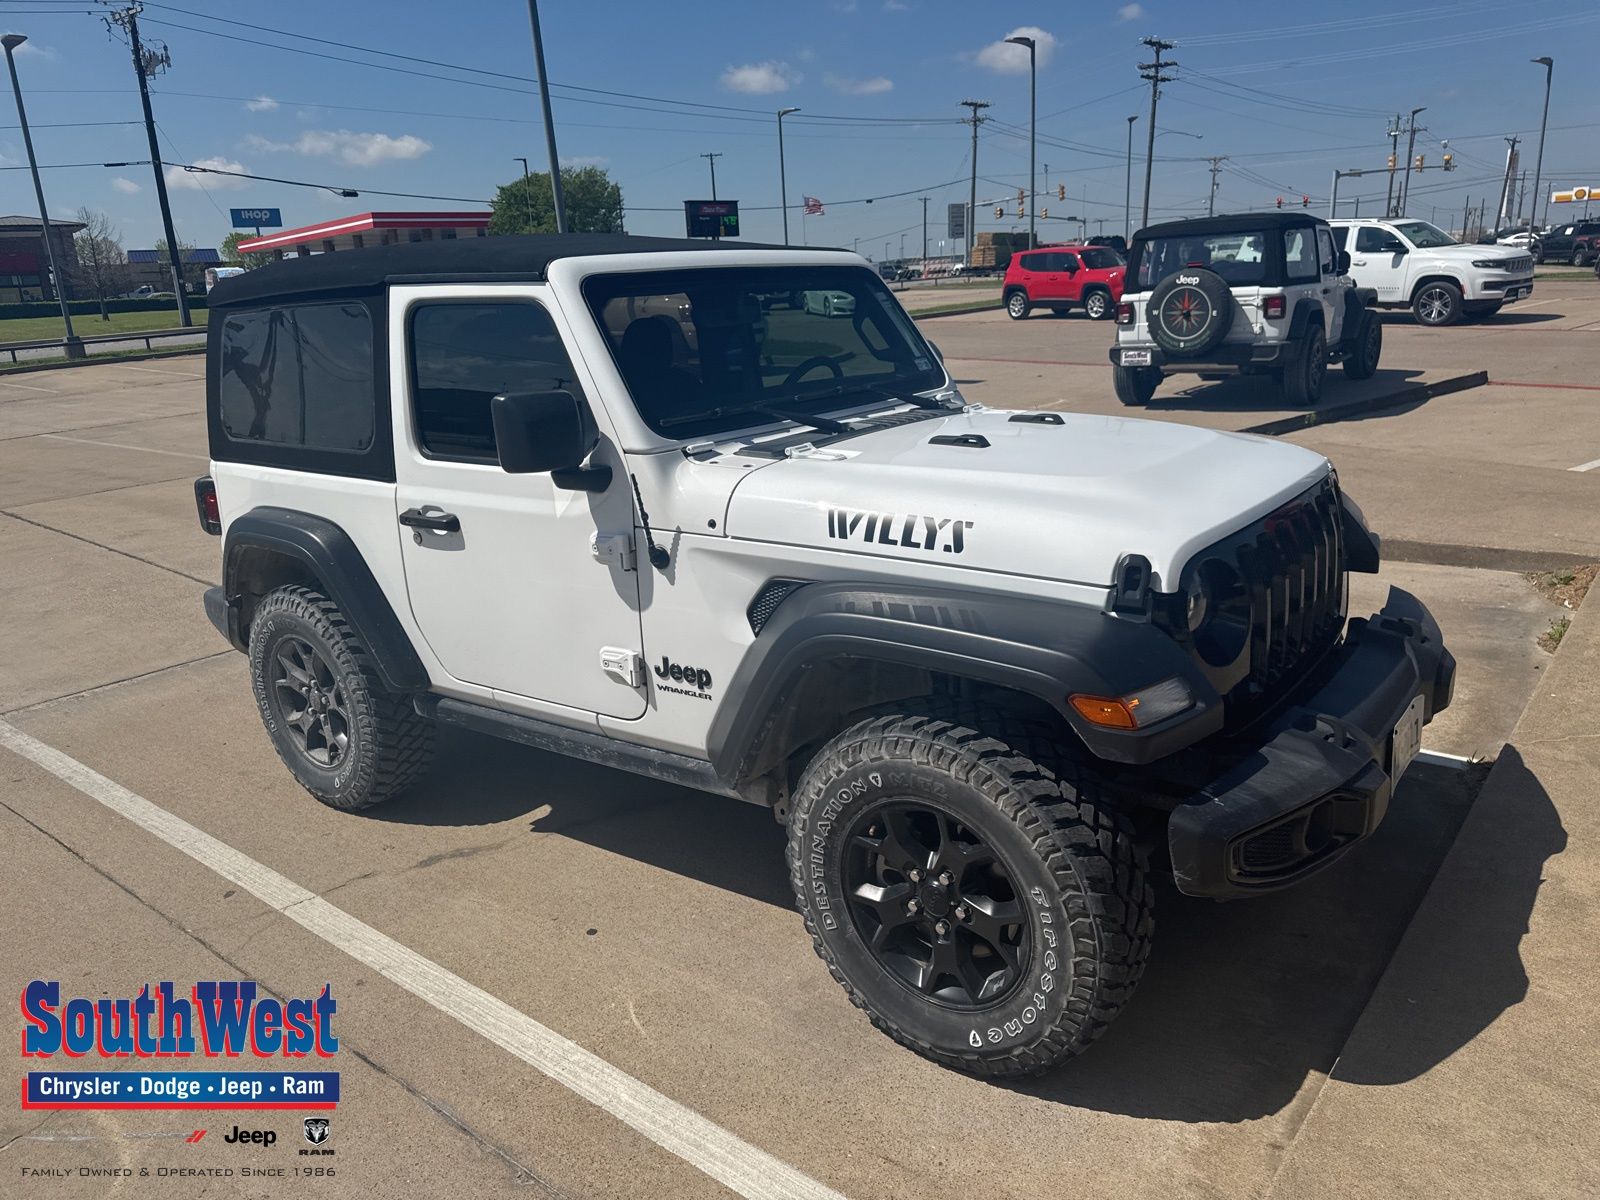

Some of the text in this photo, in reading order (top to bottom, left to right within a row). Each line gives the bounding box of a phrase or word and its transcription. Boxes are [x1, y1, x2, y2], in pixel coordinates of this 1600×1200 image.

[1175, 275, 1200, 286] Jeep
[827, 509, 975, 554] WILLYS
[654, 655, 713, 691] Jeep
[656, 683, 713, 701] WRANGLER
[811, 777, 869, 930] DESTINATION
[987, 886, 1057, 1044] Firestone
